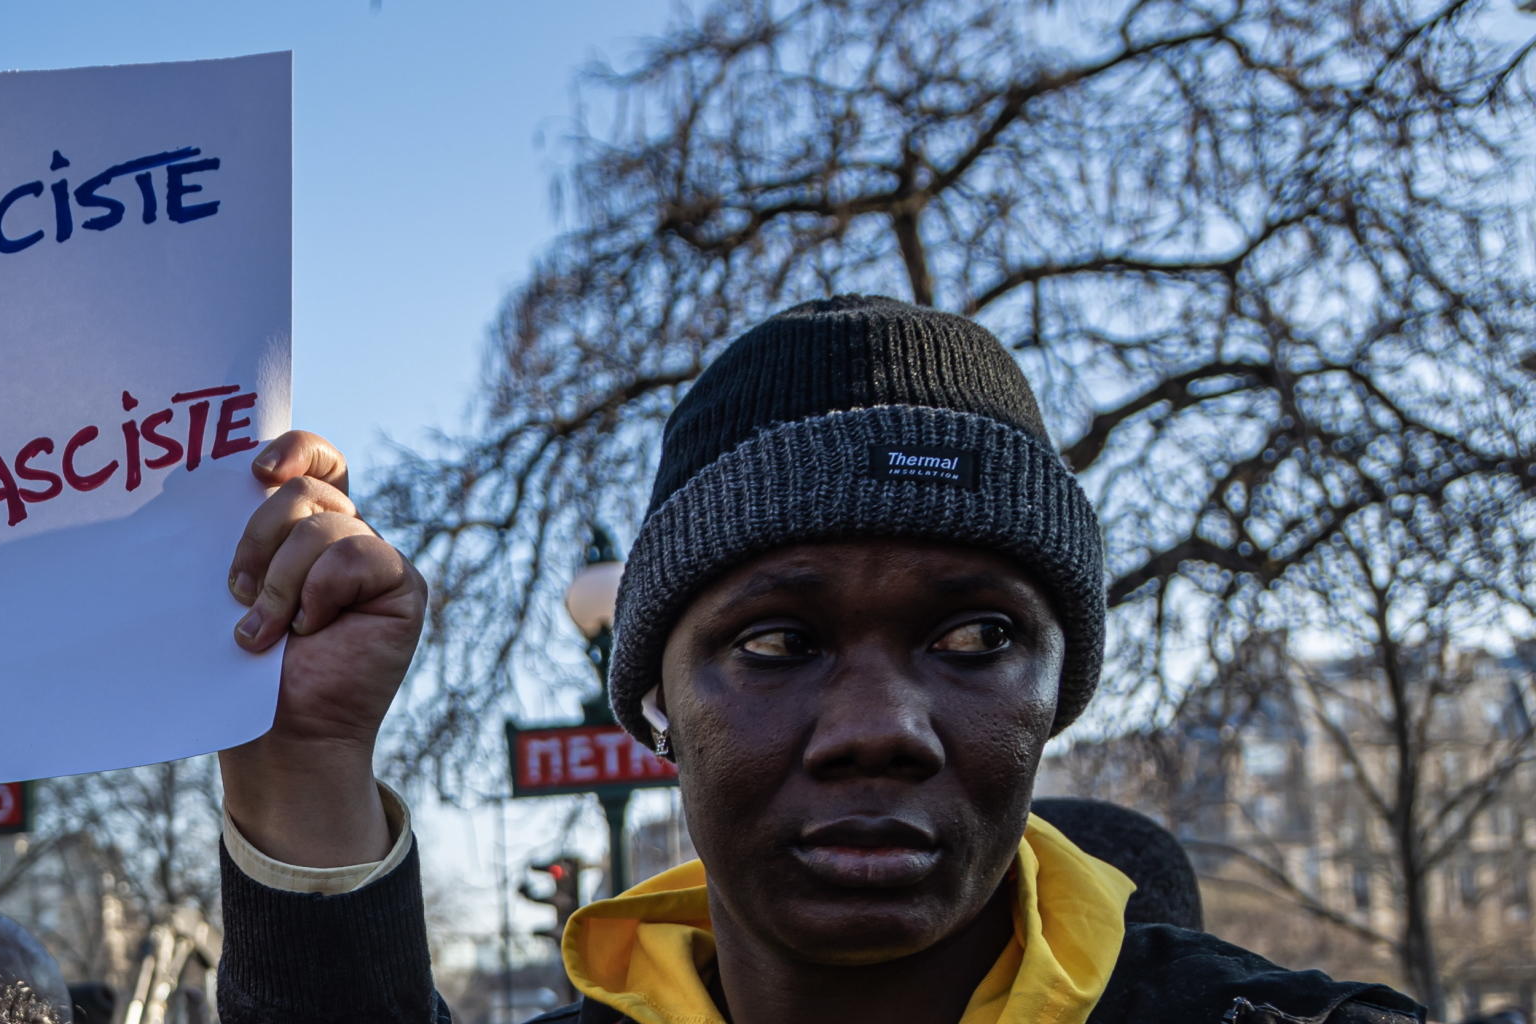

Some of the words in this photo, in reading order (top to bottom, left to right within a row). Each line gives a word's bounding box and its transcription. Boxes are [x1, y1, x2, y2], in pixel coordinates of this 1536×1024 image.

[888, 452, 959, 471] Thermal
[888, 469, 960, 481] INSULATION
[527, 732, 669, 785] METR
